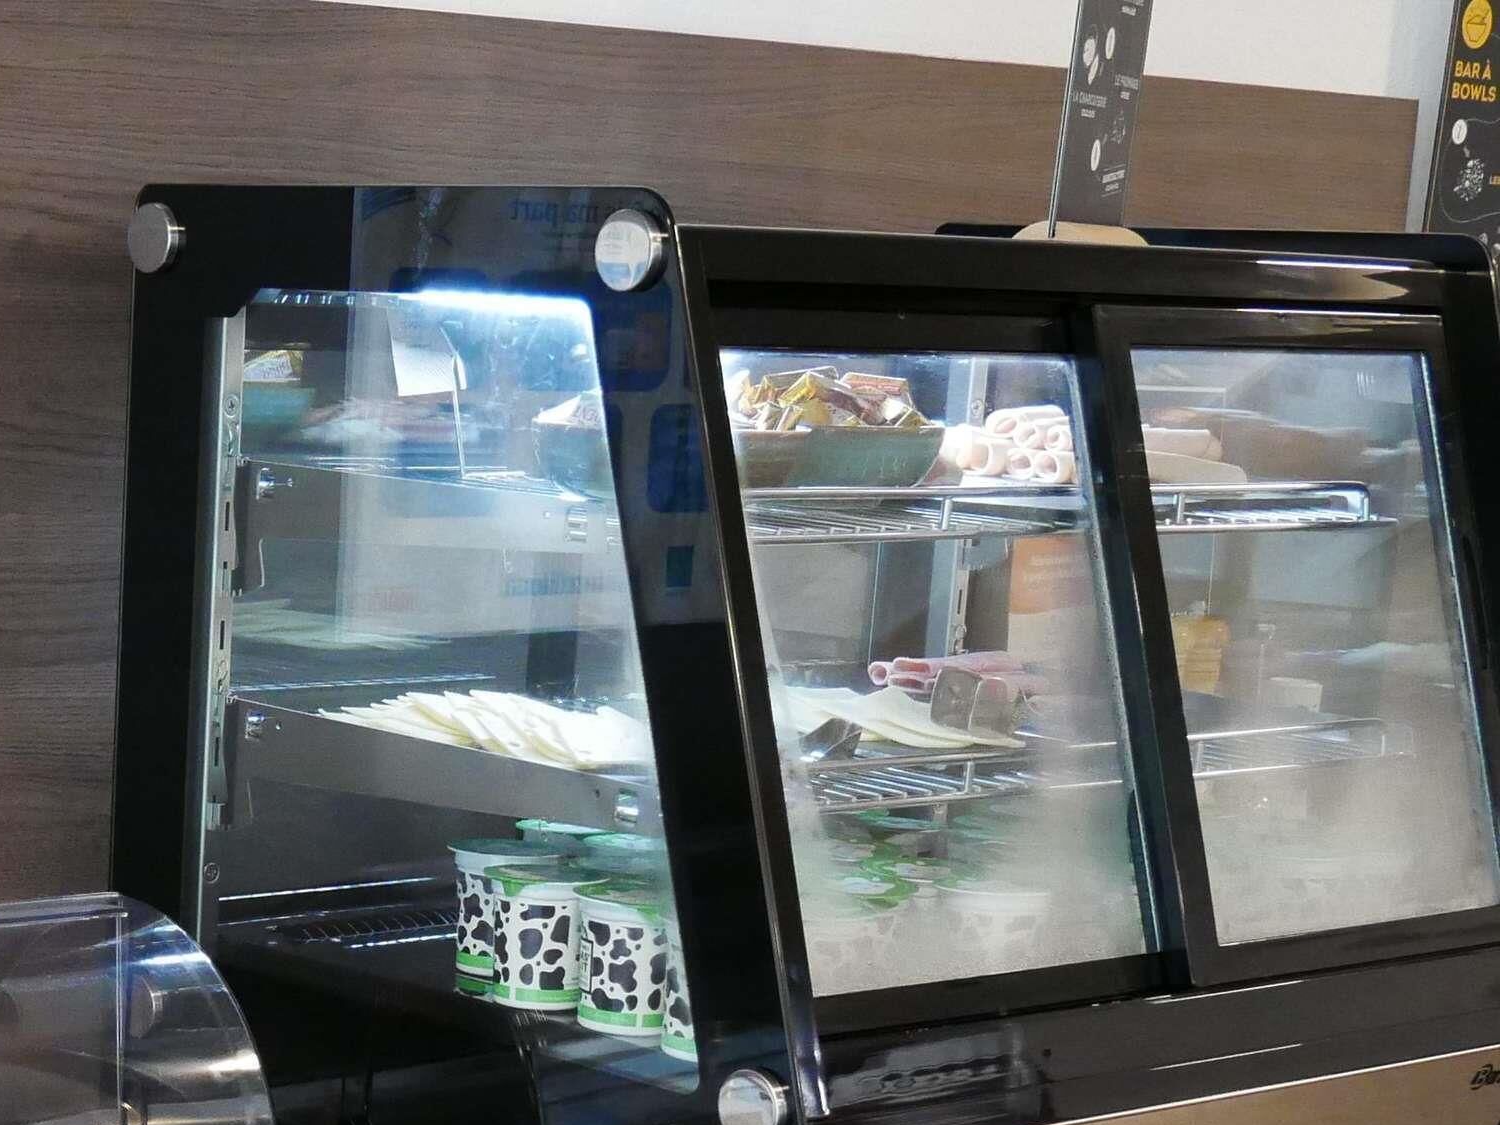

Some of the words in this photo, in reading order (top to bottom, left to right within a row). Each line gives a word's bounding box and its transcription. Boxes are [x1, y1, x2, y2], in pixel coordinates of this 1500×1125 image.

[1455, 60, 1480, 78] BAR
[1483, 60, 1492, 79] À
[1451, 82, 1497, 102] BOWLS
